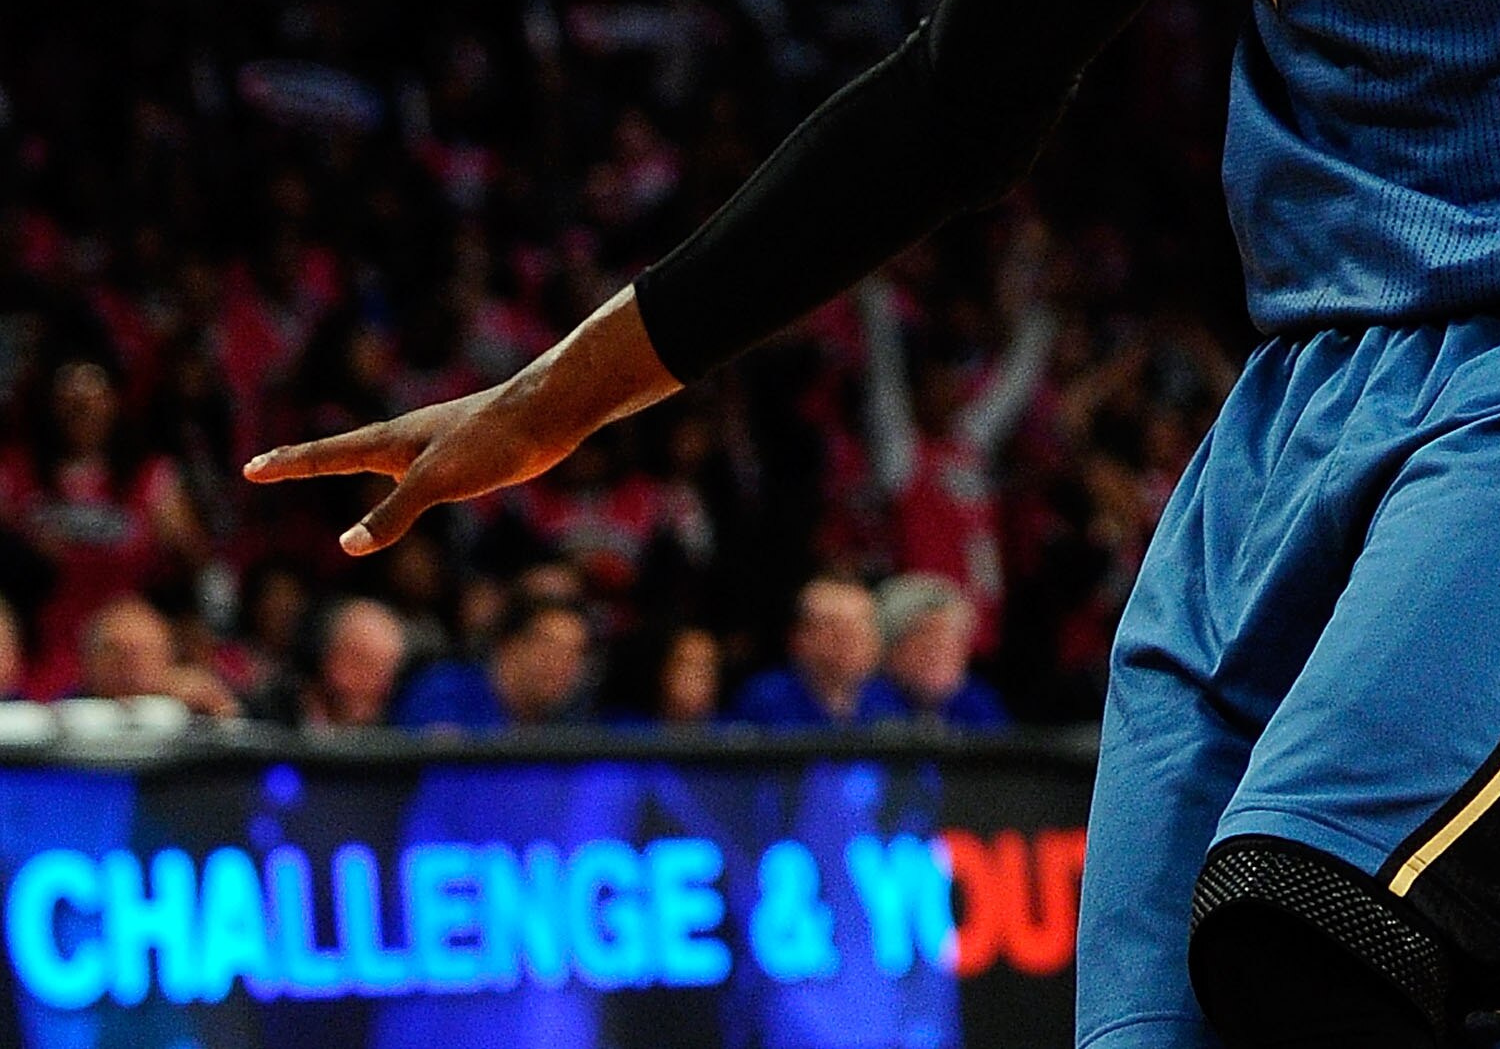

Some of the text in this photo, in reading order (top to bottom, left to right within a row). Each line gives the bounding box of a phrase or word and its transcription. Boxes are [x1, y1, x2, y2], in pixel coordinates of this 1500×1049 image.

[7, 826, 1088, 1009] CHALLENGE & YOU
